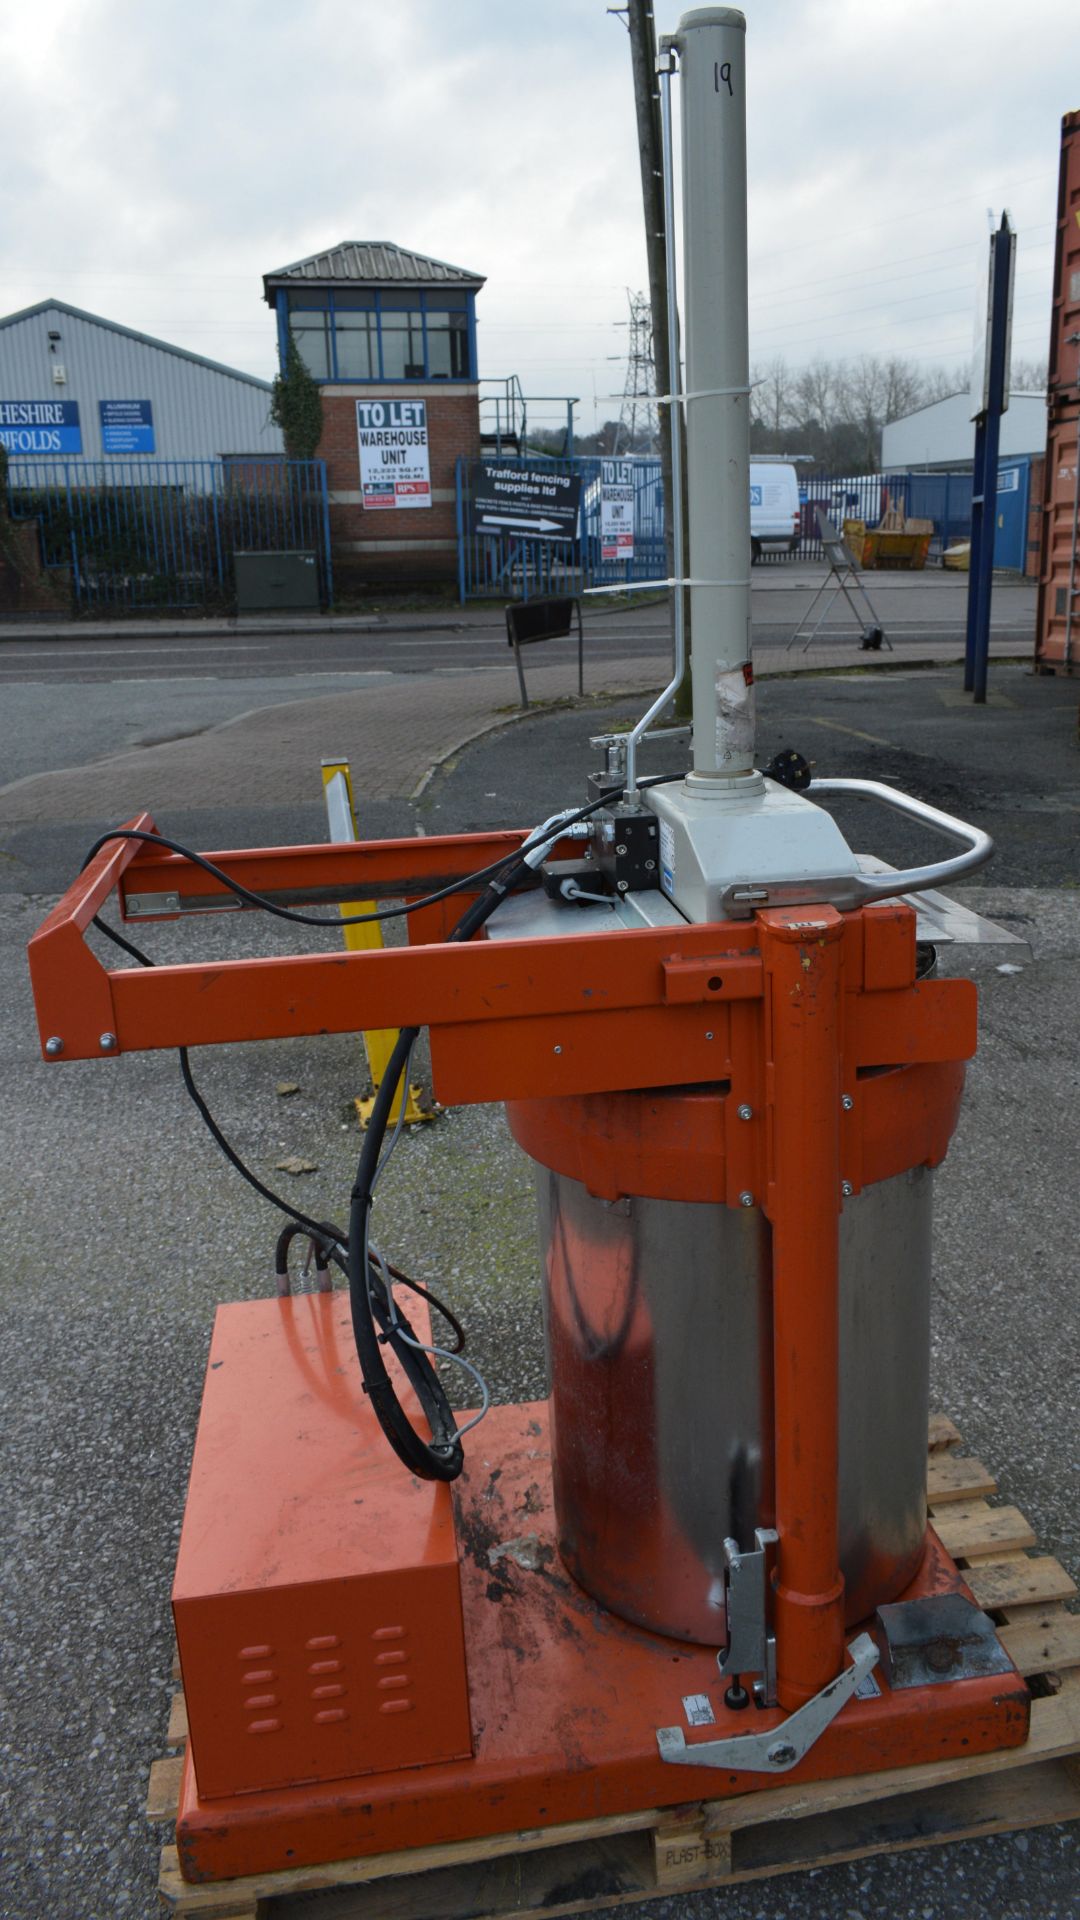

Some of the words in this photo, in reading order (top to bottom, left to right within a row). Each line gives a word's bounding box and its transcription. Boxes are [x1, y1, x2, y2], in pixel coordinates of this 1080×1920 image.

[714, 62, 733, 96] 19
[360, 403, 385, 427] TO
[390, 403, 424, 426] LET
[360, 431, 427, 447] WAREHOUSE
[381, 450, 407, 465] UNIT
[485, 467, 529, 481] Trafford
[531, 472, 571, 488] fencing
[602, 462, 615, 483] TO
[616, 462, 633, 483] LET
[494, 482, 540, 494] supplies
[542, 485, 557, 496] ltd
